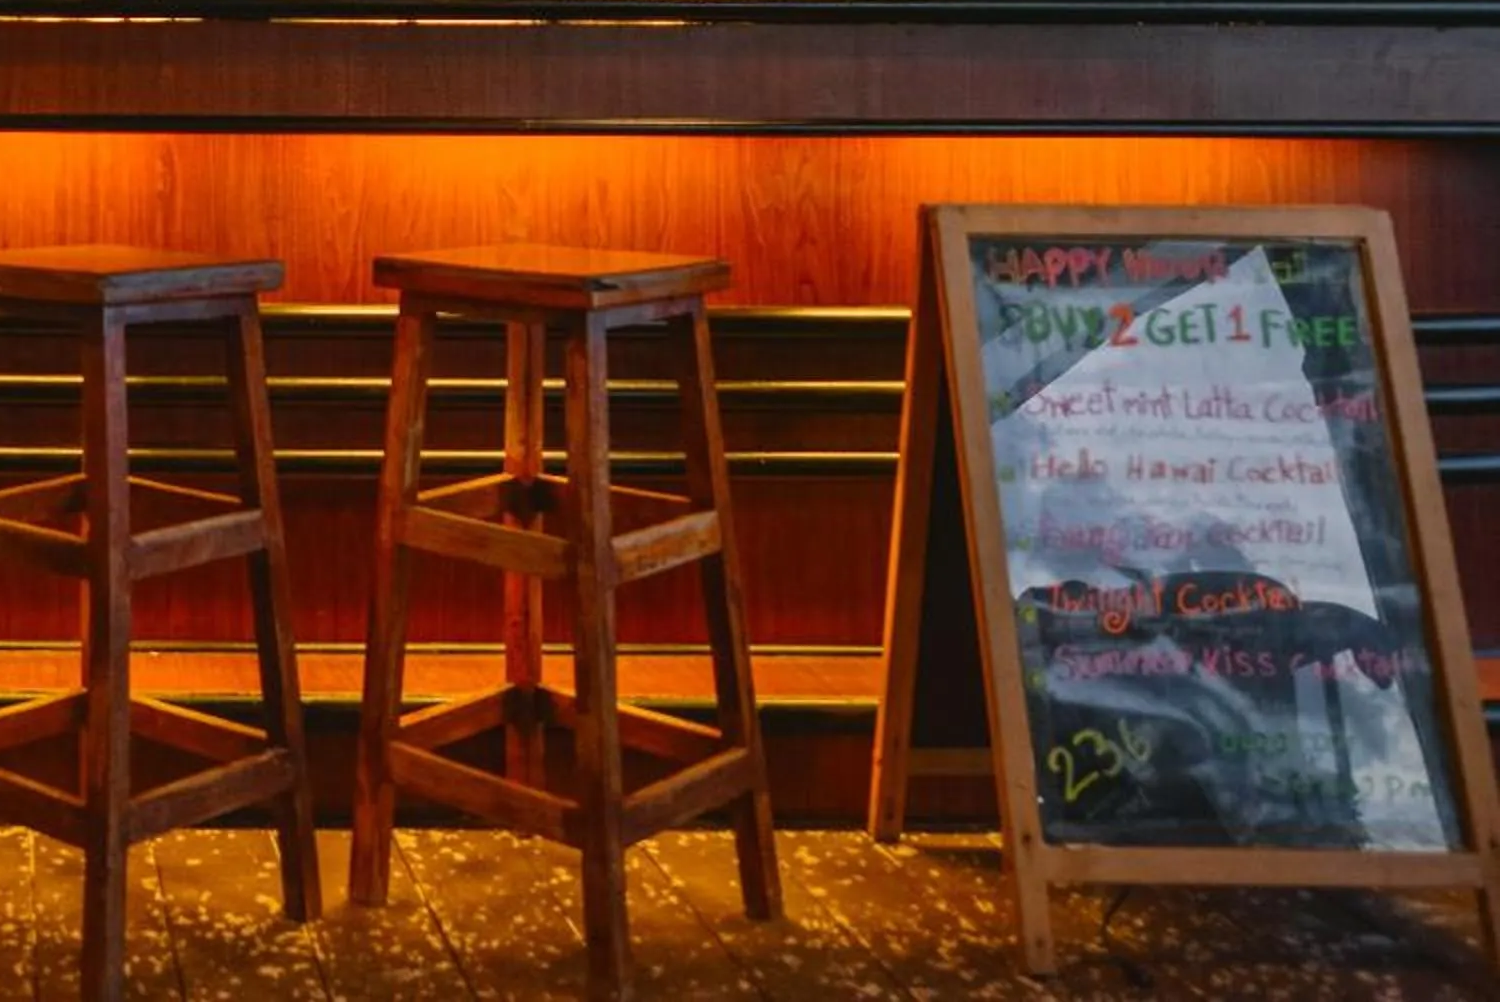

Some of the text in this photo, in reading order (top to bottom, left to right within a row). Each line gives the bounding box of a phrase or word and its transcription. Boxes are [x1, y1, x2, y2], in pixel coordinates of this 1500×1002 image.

[1108, 302, 1140, 347] 2
[1145, 303, 1218, 346] GET
[1226, 304, 1251, 342] 1
